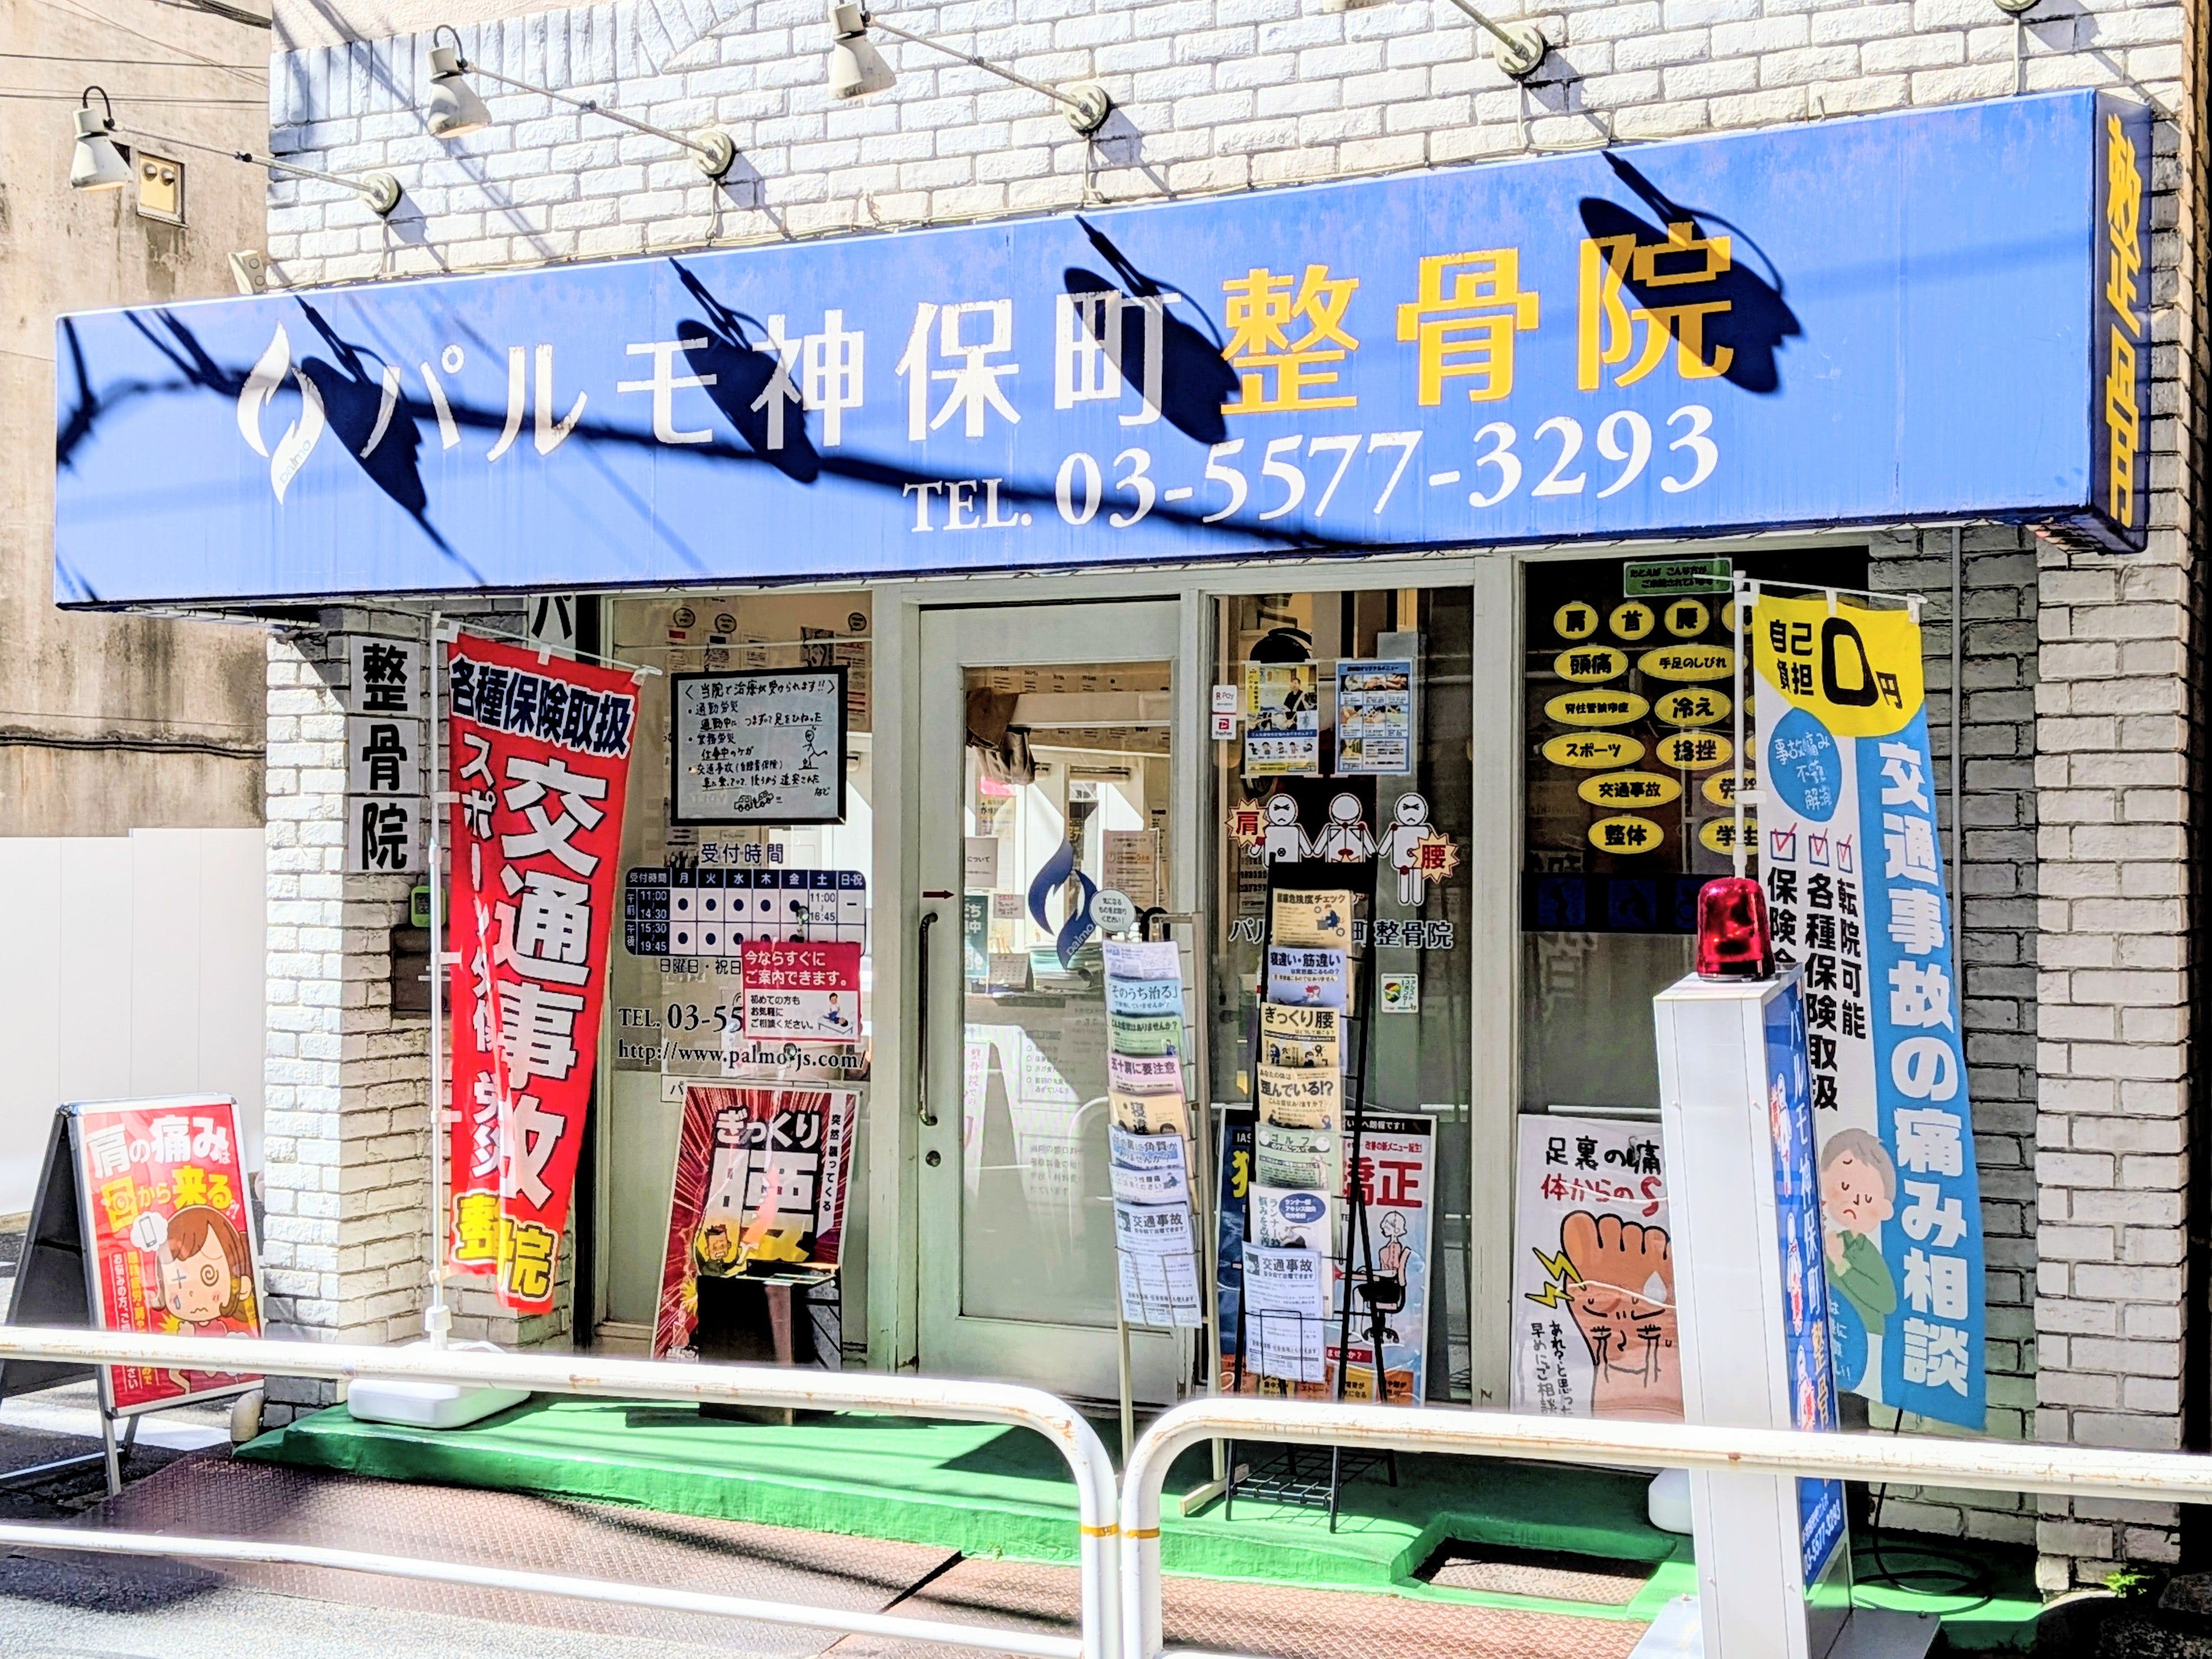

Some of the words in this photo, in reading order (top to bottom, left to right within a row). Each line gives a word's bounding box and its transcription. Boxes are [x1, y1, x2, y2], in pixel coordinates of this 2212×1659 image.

[360, 220, 1735, 462] パルモ神保町整骨院
[278, 436, 312, 487] palmo
[903, 478, 1032, 533] TEL.
[1055, 404, 1720, 529] 03-5577-3293
[1566, 610, 1586, 632] 肩
[1622, 610, 1643, 632] 首
[1676, 607, 1698, 630] 腰
[1770, 619, 1813, 656] 自己
[1570, 654, 1612, 675] 頭痛
[1659, 657, 1727, 669] 手足のしびれ
[450, 657, 632, 756] 各種保険取扱
[1672, 697, 1715, 719] 冷え
[361, 644, 408, 870] 整骨院
[1566, 742, 1622, 758] スポーツ
[1673, 740, 1717, 762] 捻挫
[1598, 782, 1661, 798] 交通事故
[1236, 811, 1260, 836] 肩
[1604, 825, 1647, 846] 整体
[701, 843, 784, 864] 受付時間
[1420, 844, 1446, 869] 腰
[629, 872, 667, 884] 受付時間
[679, 872, 689, 884] 月
[706, 872, 716, 884] 火
[733, 872, 744, 884] 水
[761, 873, 771, 884] 木
[789, 874, 799, 885] 金
[817, 874, 827, 885] 土
[627, 894, 635, 916] 午前
[641, 891, 666, 901] 11:00
[810, 893, 835, 903] 11:00
[641, 909, 666, 919] 14:30
[627, 925, 635, 947] 午後
[641, 923, 666, 933] 15:30
[1066, 923, 1095, 956] palmo
[641, 942, 666, 952] 19:45
[745, 951, 826, 967] 今ならすぐに
[1837, 877, 1867, 1040] 転院可能
[495, 756, 608, 1211] 交通事故
[745, 970, 847, 986] ご案内できます。
[751, 995, 801, 1005] 初めての方も
[1805, 872, 1838, 1111] 各種保険取扱
[618, 1008, 660, 1028] TEL.
[751, 1007, 783, 1017] お気軽に
[1265, 1007, 1334, 1029] ぎっくり腰
[751, 1018, 814, 1030] ご相談ください。
[1111, 1058, 1176, 1075] 五十肩に要注意
[1879, 742, 1969, 1397] 交通事故の痛み相談
[716, 1107, 820, 1149] ぎっくり
[85, 1115, 231, 1180] 肩の痛みは
[1271, 1134, 1309, 1146] ゴルフ
[1545, 1136, 1661, 1175] 足裏の痛
[1133, 1213, 1183, 1227] 交通事故
[1790, 1002, 1830, 1431] パルモ神保町整骨
[1262, 1257, 1313, 1273] 交通事故
[1327, 1349, 1363, 1359] ませか?
